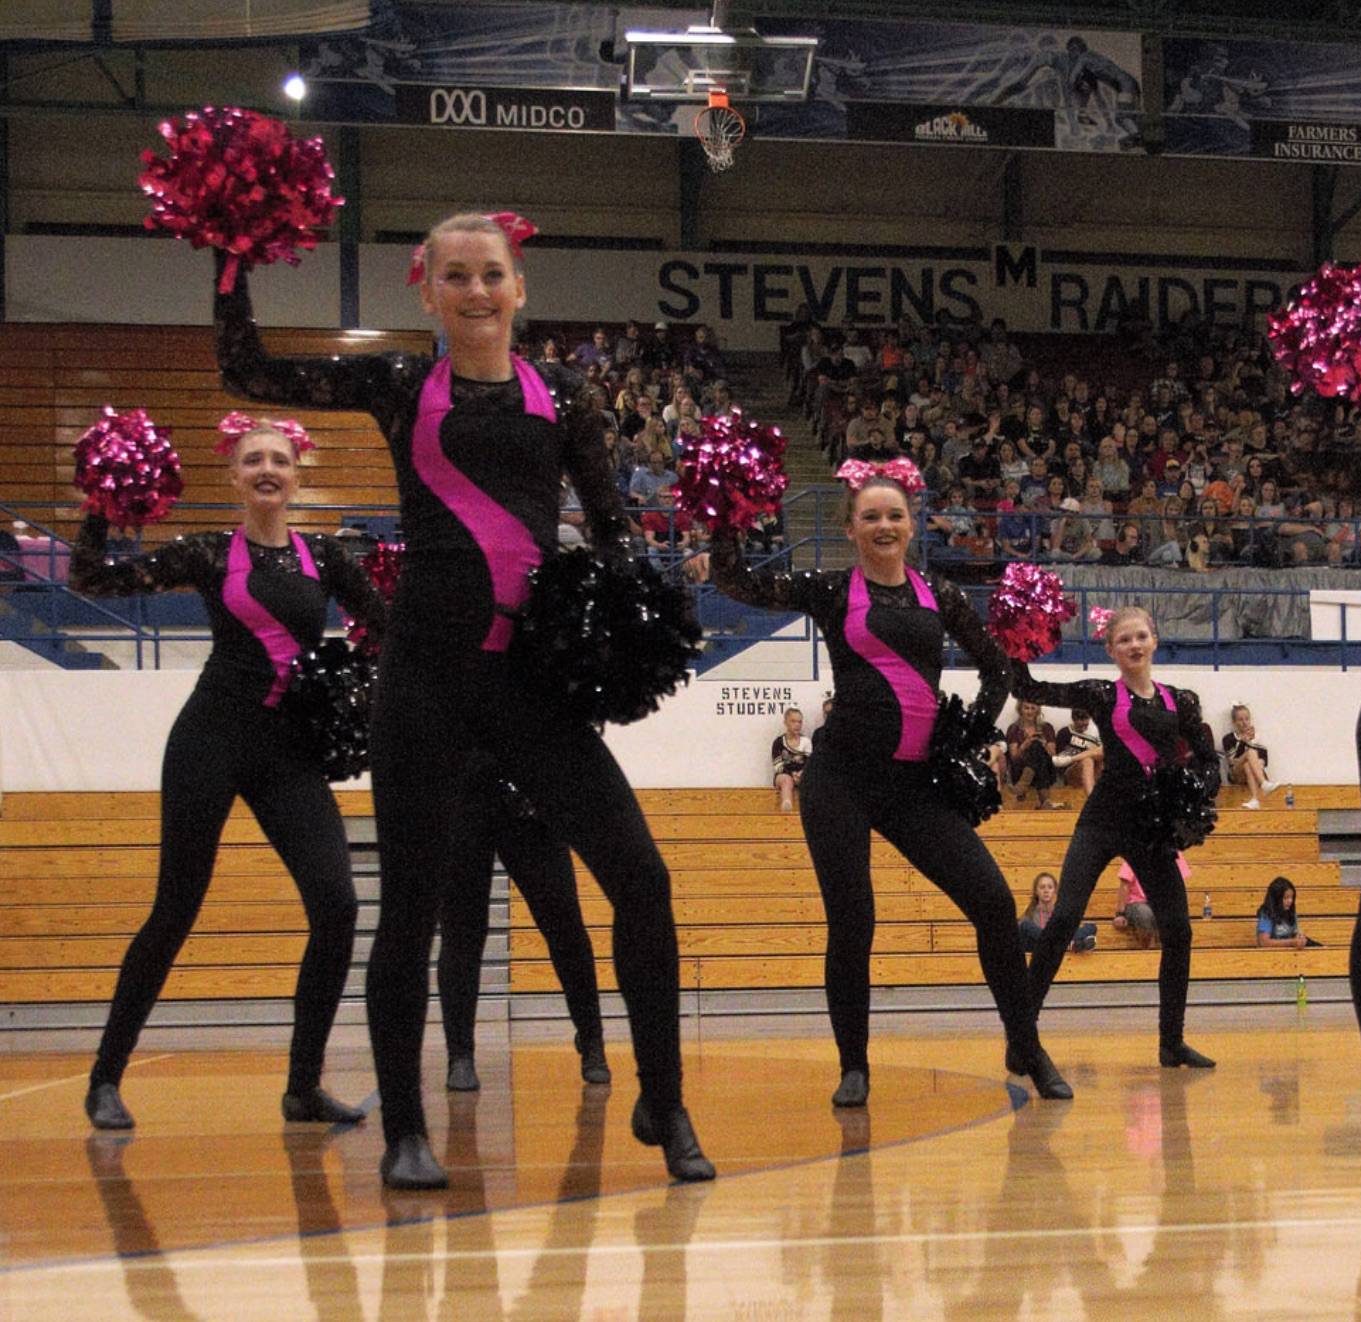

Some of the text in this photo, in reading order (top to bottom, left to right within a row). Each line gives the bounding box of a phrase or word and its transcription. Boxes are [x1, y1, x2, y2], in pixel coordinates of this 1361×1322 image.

[496, 104, 585, 129] MIDCO
[1288, 125, 1358, 142] FARMERS
[995, 245, 1038, 288] M
[657, 260, 1303, 335] STEVENS RAIDER
[721, 687, 792, 700] STEVENS
[716, 702, 798, 716] STUDENT
